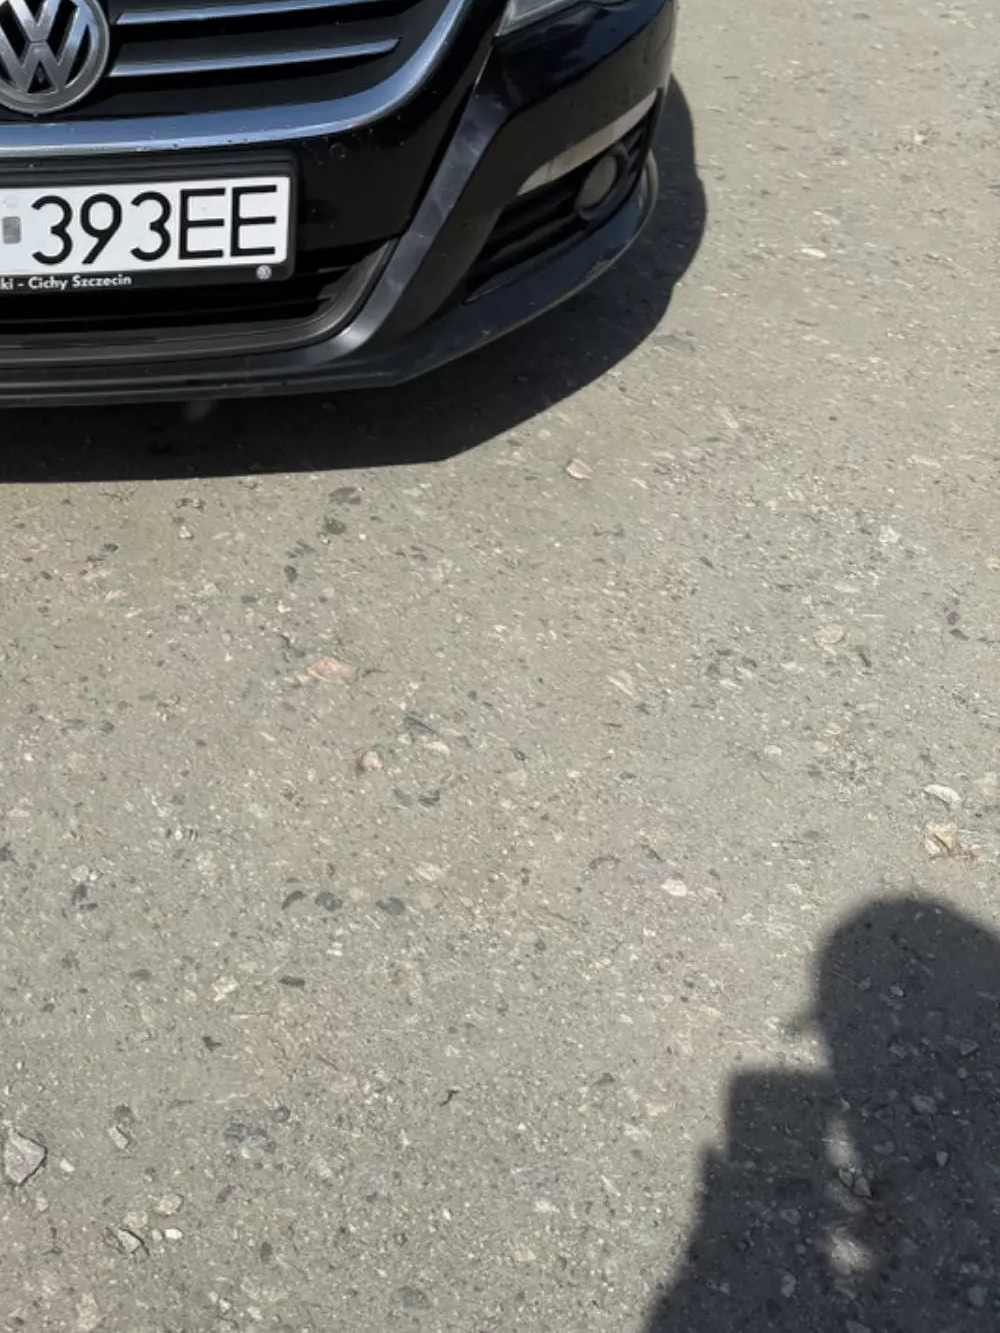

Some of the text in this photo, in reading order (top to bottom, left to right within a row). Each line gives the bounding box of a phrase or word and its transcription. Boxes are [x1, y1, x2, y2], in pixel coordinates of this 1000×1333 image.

[31, 184, 278, 266] 393EE
[28, 276, 68, 291] Cichy
[72, 274, 132, 288] Szczecin
